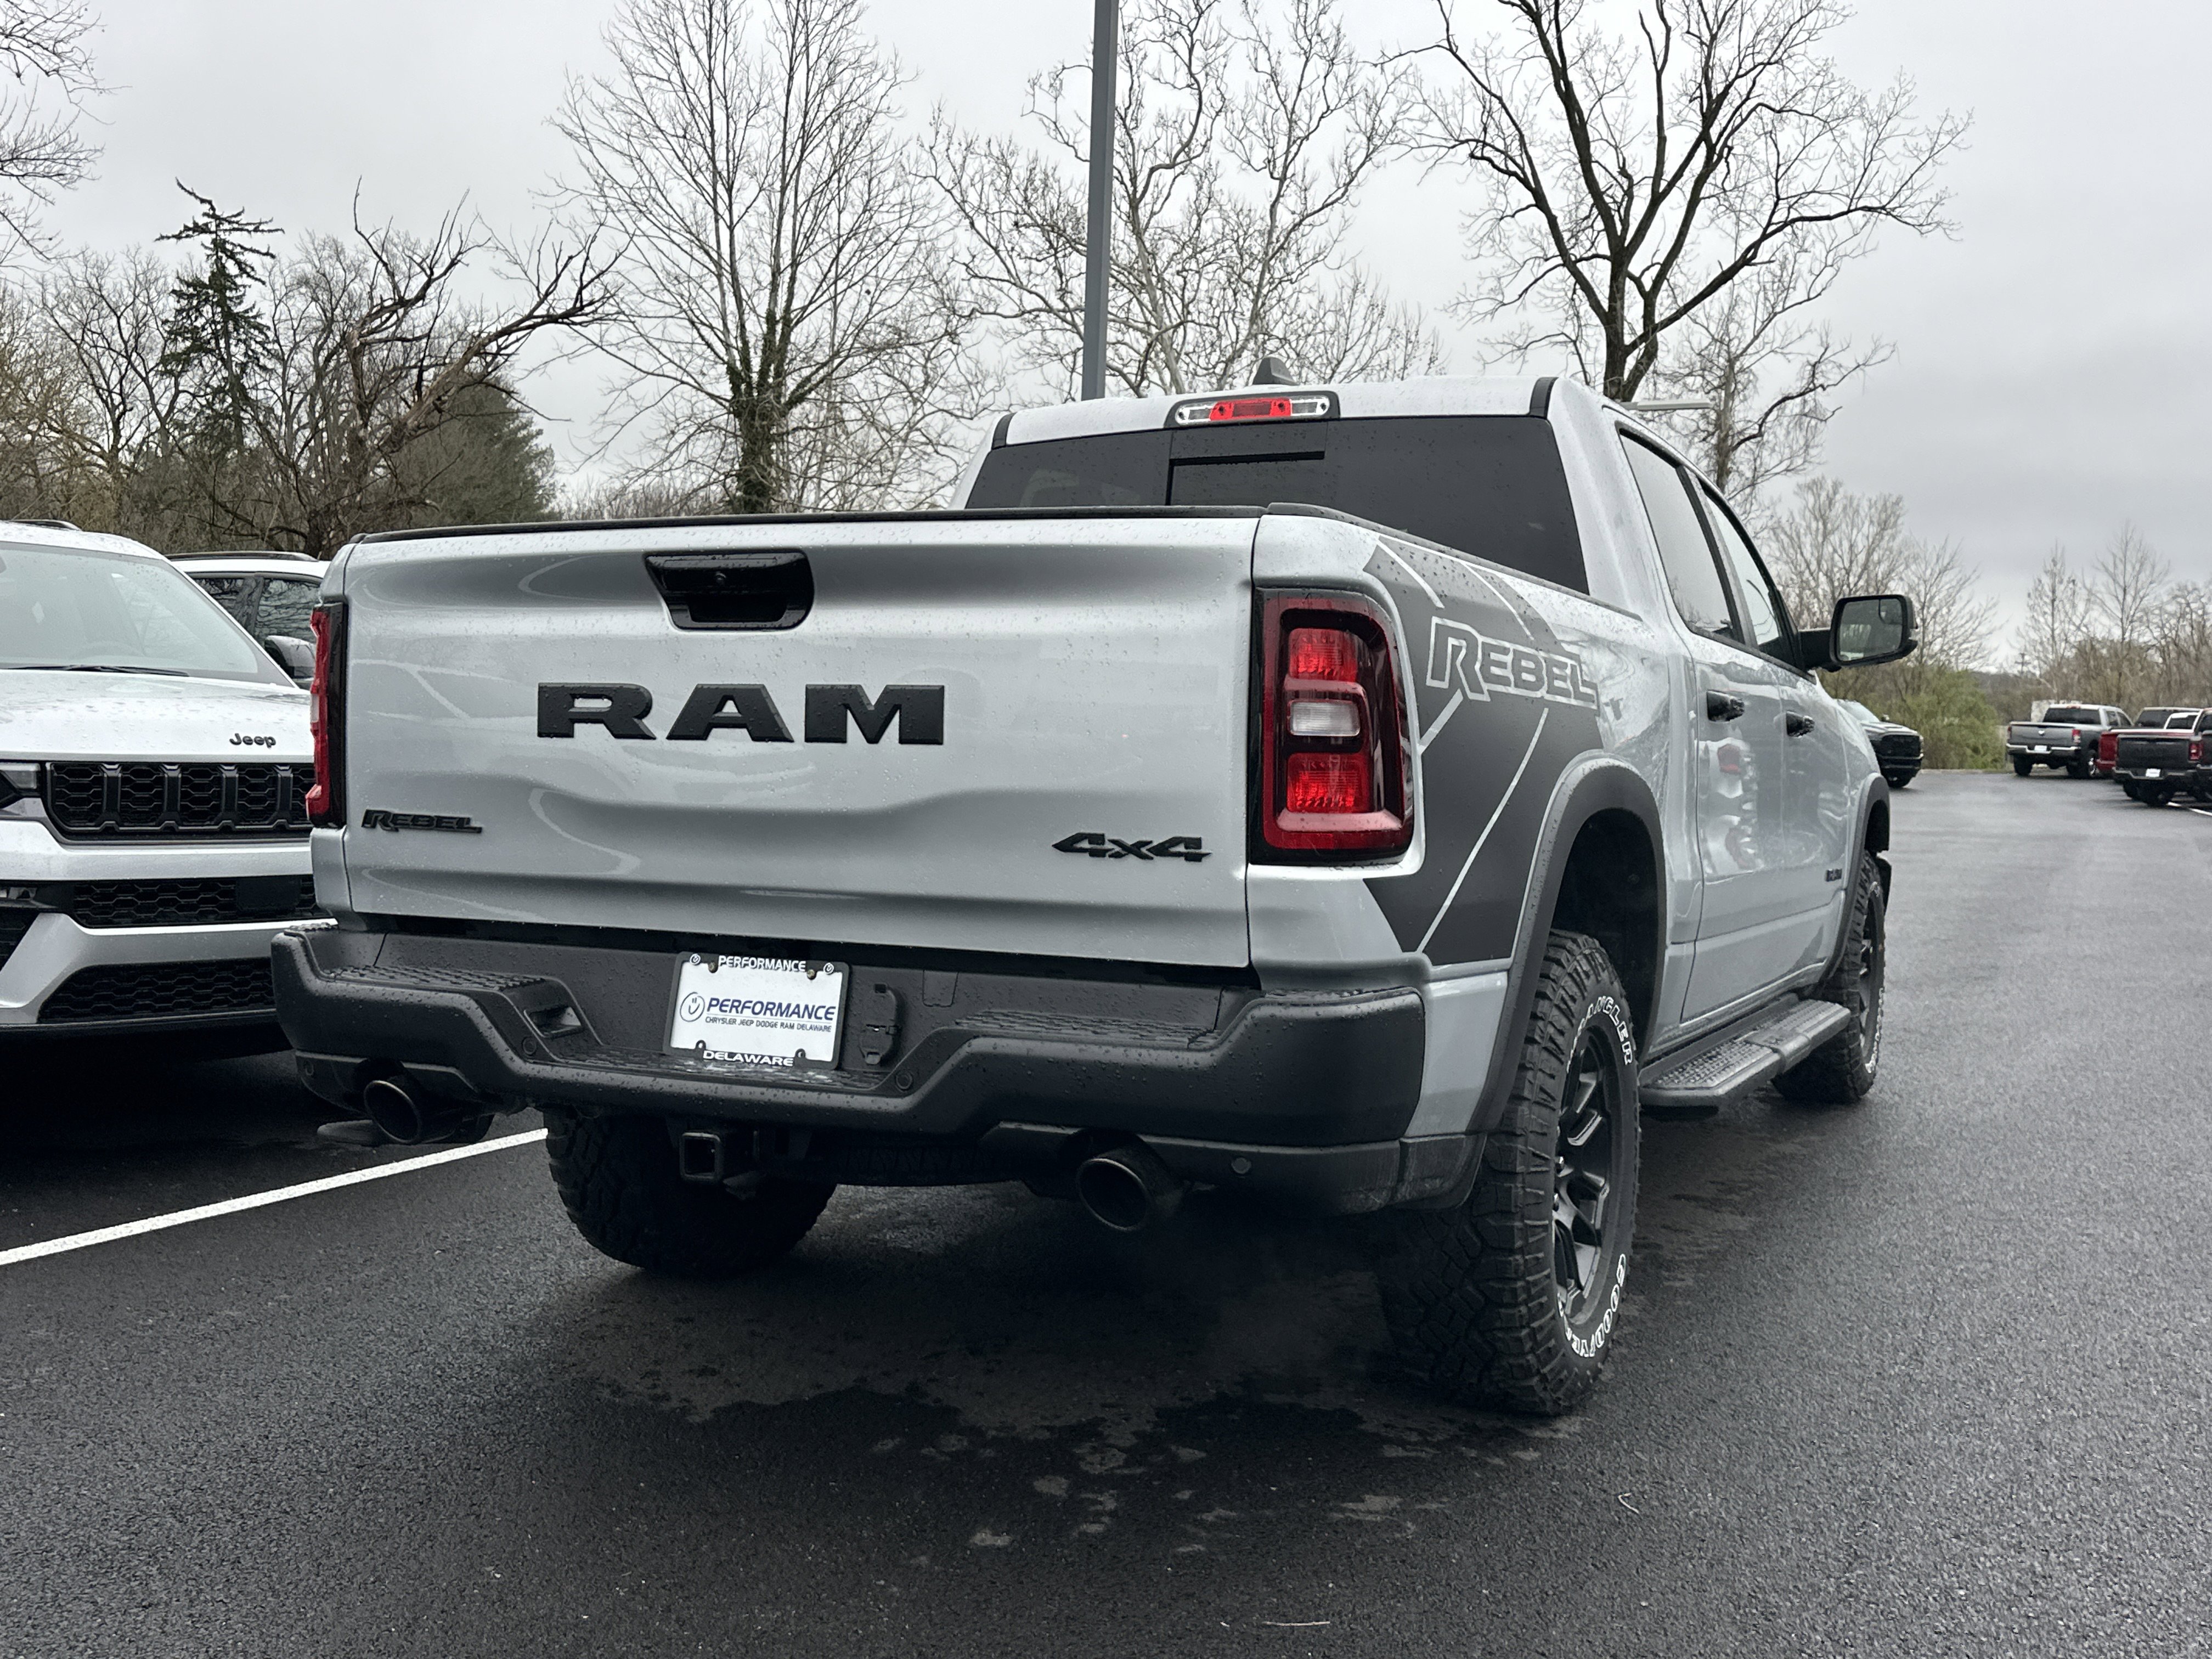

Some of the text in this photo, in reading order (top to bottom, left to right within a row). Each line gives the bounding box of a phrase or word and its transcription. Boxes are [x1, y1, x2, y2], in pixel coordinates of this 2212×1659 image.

[1426, 616, 1599, 709] REBEL
[537, 682, 945, 745] RAM
[229, 733, 276, 748] Jeep
[361, 809, 482, 833] REBEL
[1051, 832, 1212, 862] 4x4
[718, 955, 806, 972] PERFORMANCE
[706, 997, 836, 1021] PERFORMANCE
[705, 1017, 737, 1025] CHRYSLER
[797, 1024, 832, 1032] DELAWARE
[1567, 995, 1633, 1074] ANGLER
[703, 1050, 794, 1066] DELAWARE
[1557, 1254, 1627, 1357] GOODYEA
